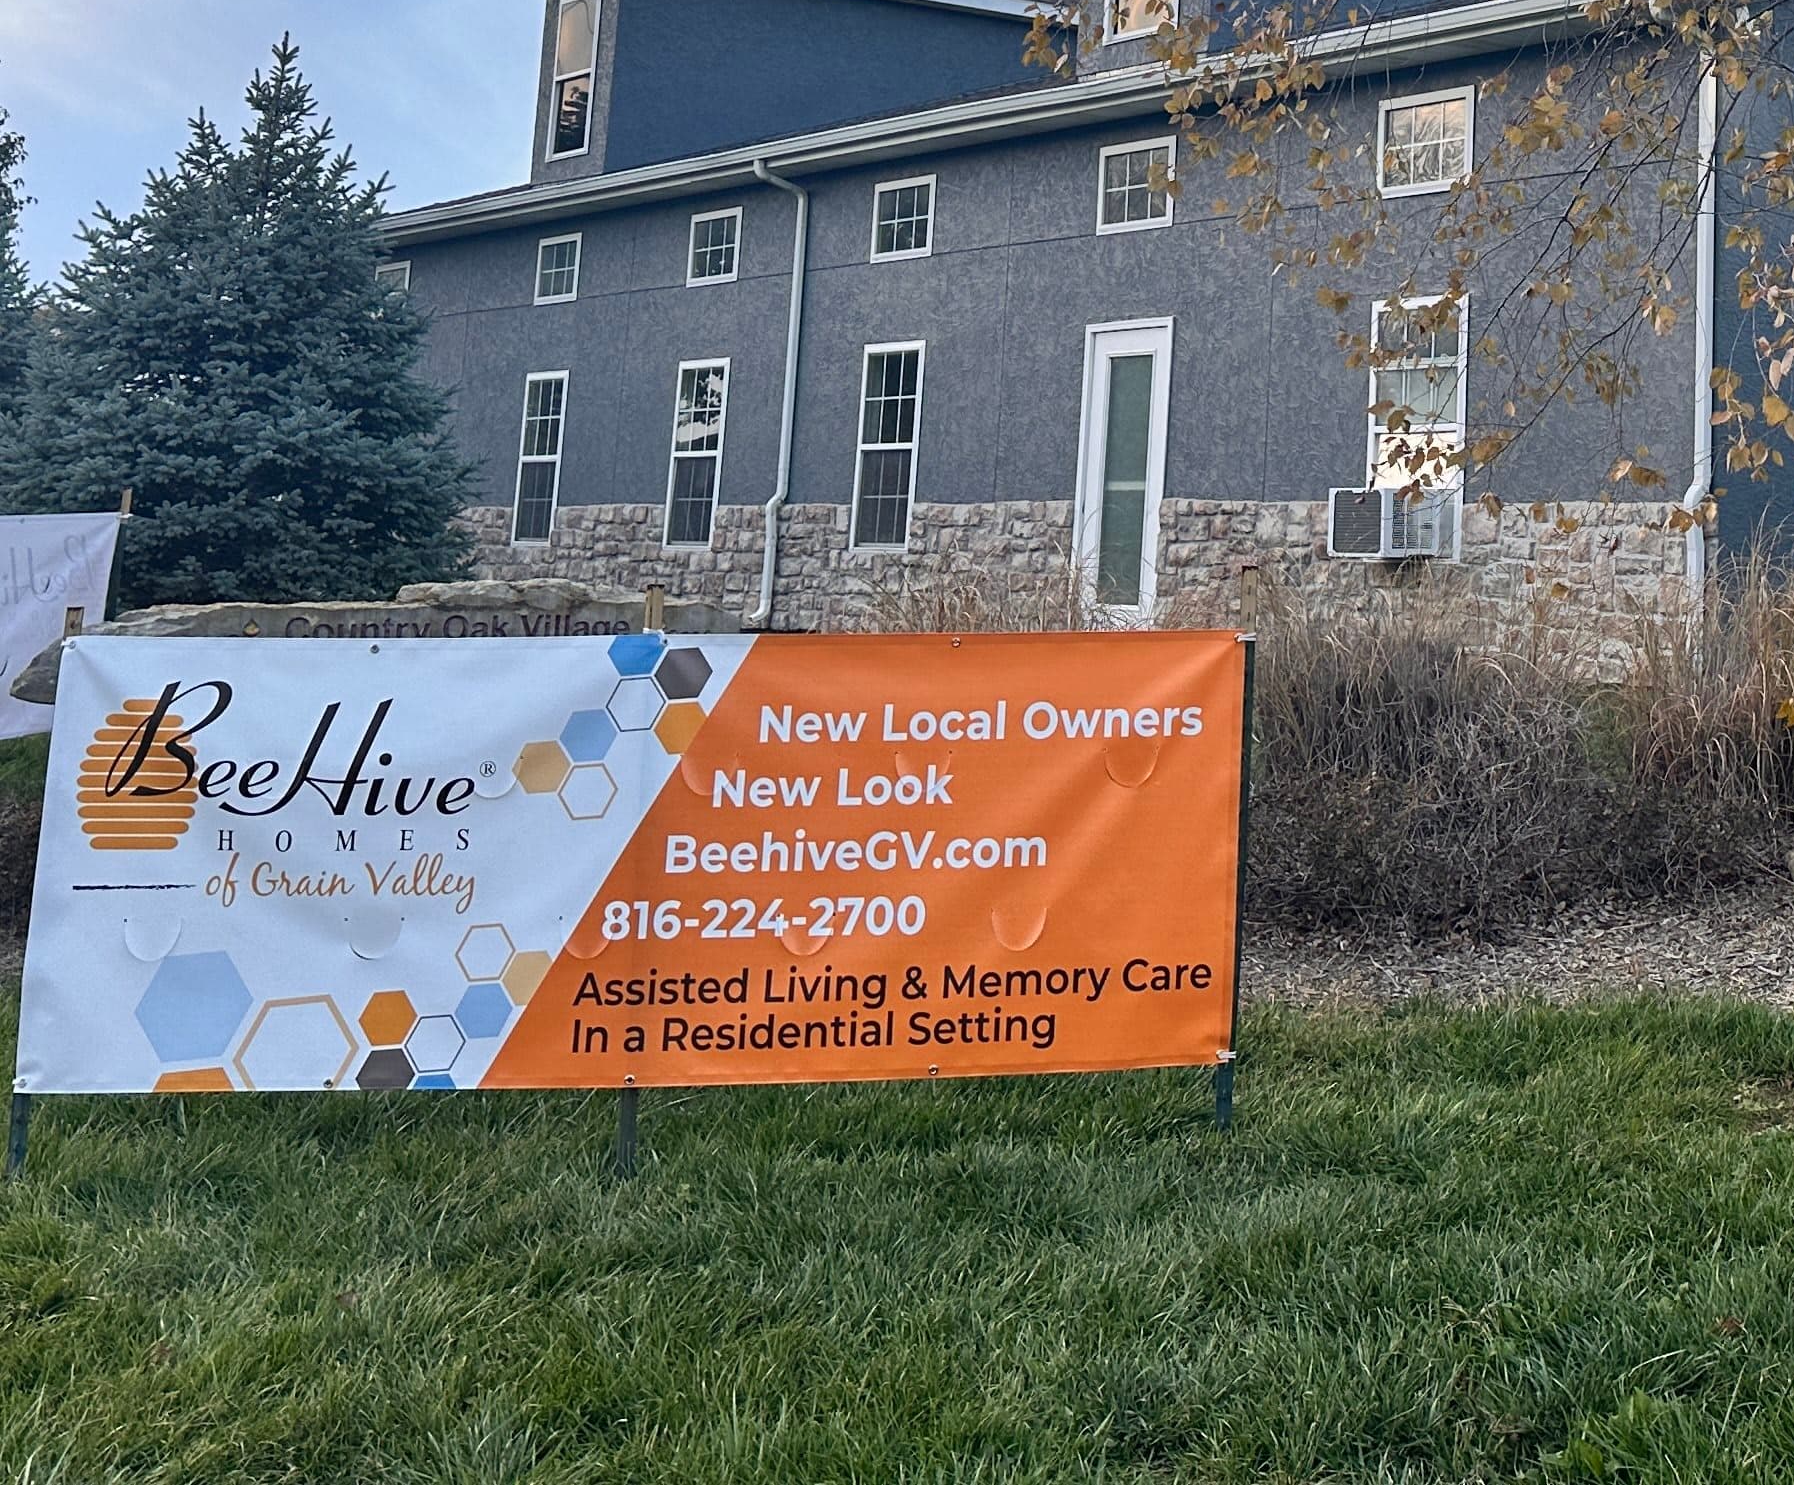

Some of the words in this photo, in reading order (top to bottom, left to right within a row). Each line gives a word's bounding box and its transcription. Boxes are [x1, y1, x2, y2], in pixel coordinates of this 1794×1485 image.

[443, 614, 509, 637] Oak
[522, 614, 630, 637] Village
[760, 704, 867, 743] New
[883, 700, 1006, 742] Local
[1022, 701, 1203, 740] Owners
[712, 769, 821, 808] New
[837, 765, 953, 806] Look
[218, 828, 470, 853] HOMES
[664, 829, 1047, 873] BeehiveGV.com
[205, 853, 239, 907] of
[251, 861, 355, 897] Grain
[365, 855, 476, 914] Valley
[602, 895, 925, 940] 816-224-2700
[572, 967, 748, 1007] Assisted
[764, 964, 887, 1010] Living
[901, 966, 928, 1000] &
[942, 962, 1110, 1003] Memory
[1122, 958, 1212, 992] Care
[572, 1018, 608, 1054] In
[623, 1025, 646, 1053] a
[662, 1010, 894, 1052] Residential
[907, 1007, 1056, 1050] Setting
